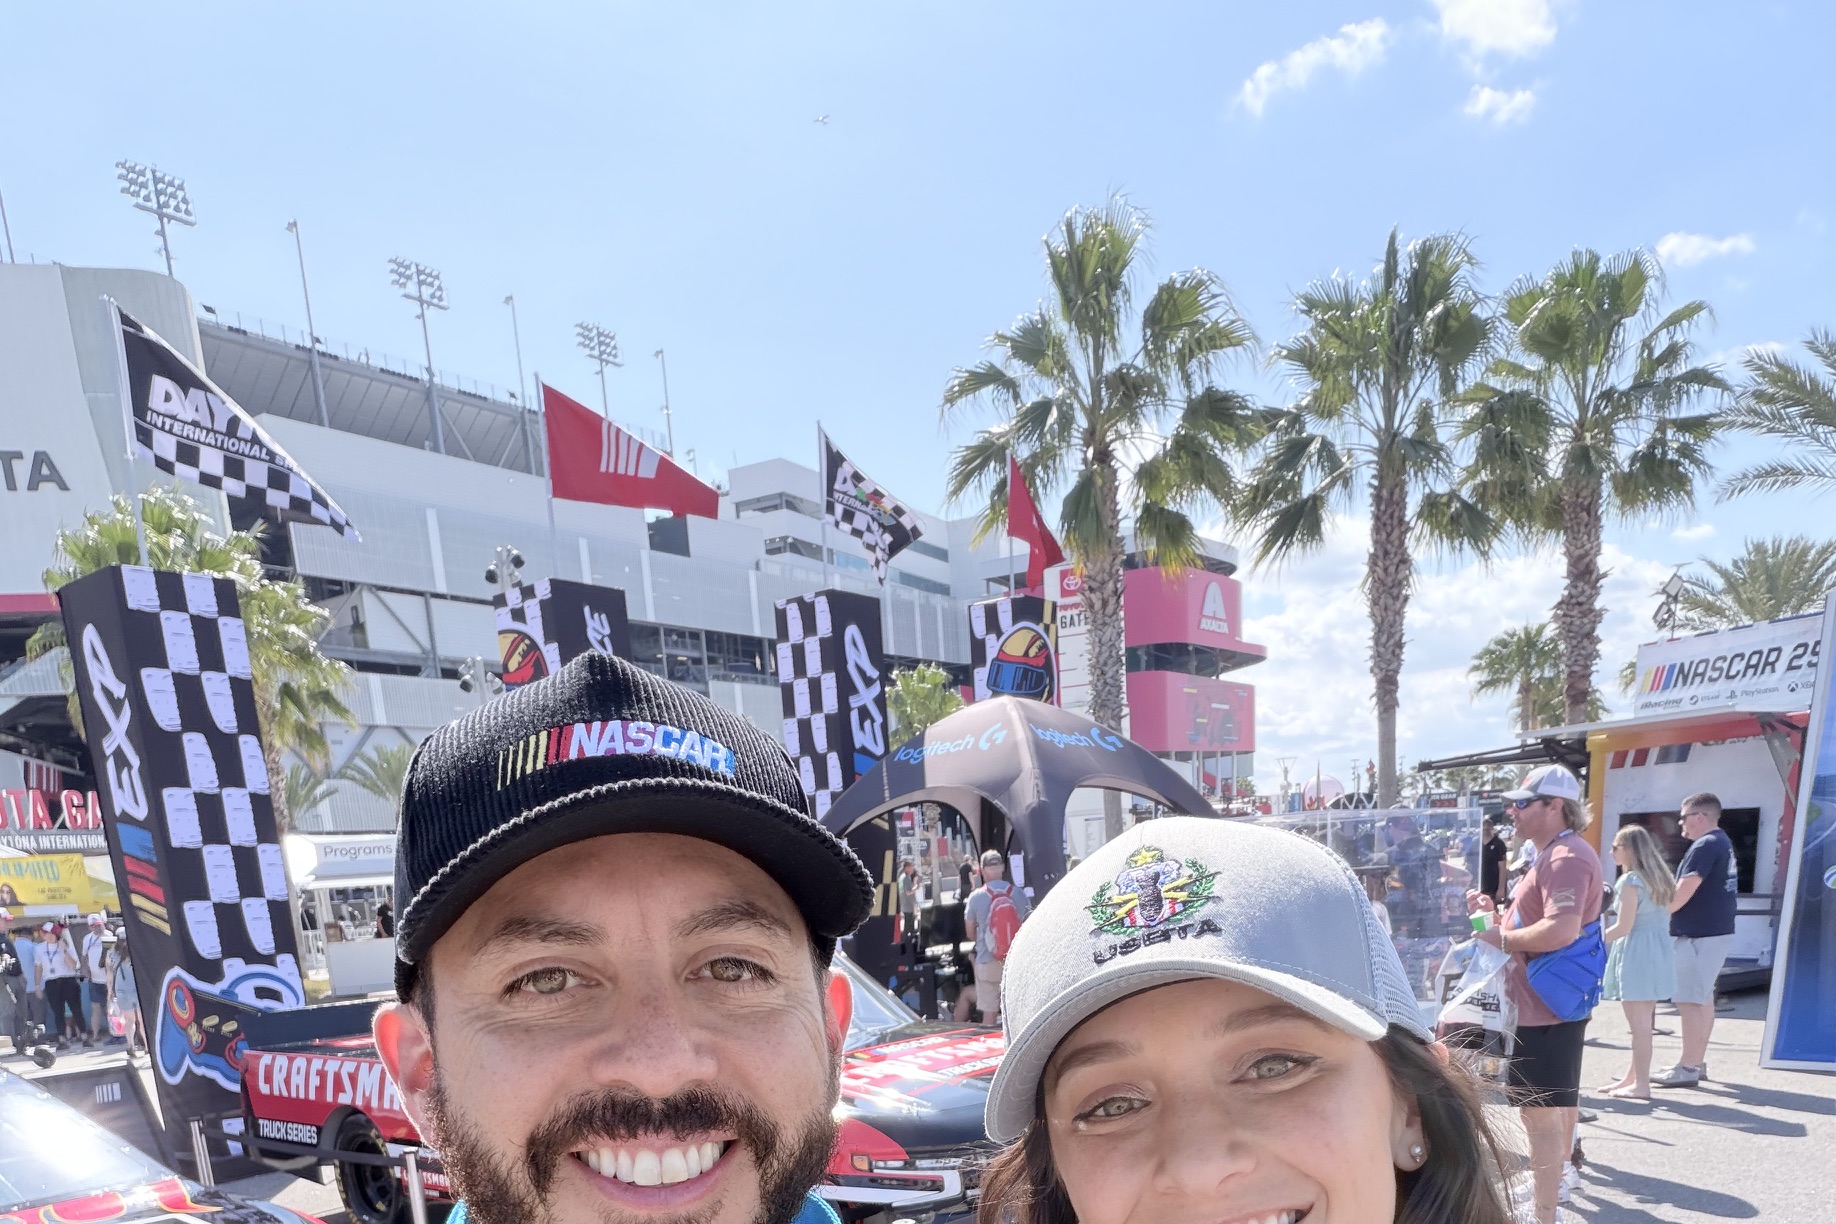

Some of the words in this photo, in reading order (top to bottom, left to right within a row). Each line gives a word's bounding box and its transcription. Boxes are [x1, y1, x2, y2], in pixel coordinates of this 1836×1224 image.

[146, 410, 270, 461] INTERNATIONAL
[1672, 646, 1783, 688] NASCAR
[844, 624, 886, 756] EXP
[1740, 686, 1779, 698] PlayStation
[82, 622, 148, 821] EXP
[1029, 723, 1094, 748] logitech
[569, 719, 734, 778] NASCAR
[893, 734, 975, 764] logitech
[39, 834, 107, 850] INTERNATION
[323, 844, 393, 861] Programs
[258, 1118, 287, 1140] TRUCK
[287, 1122, 318, 1145] SERIES
